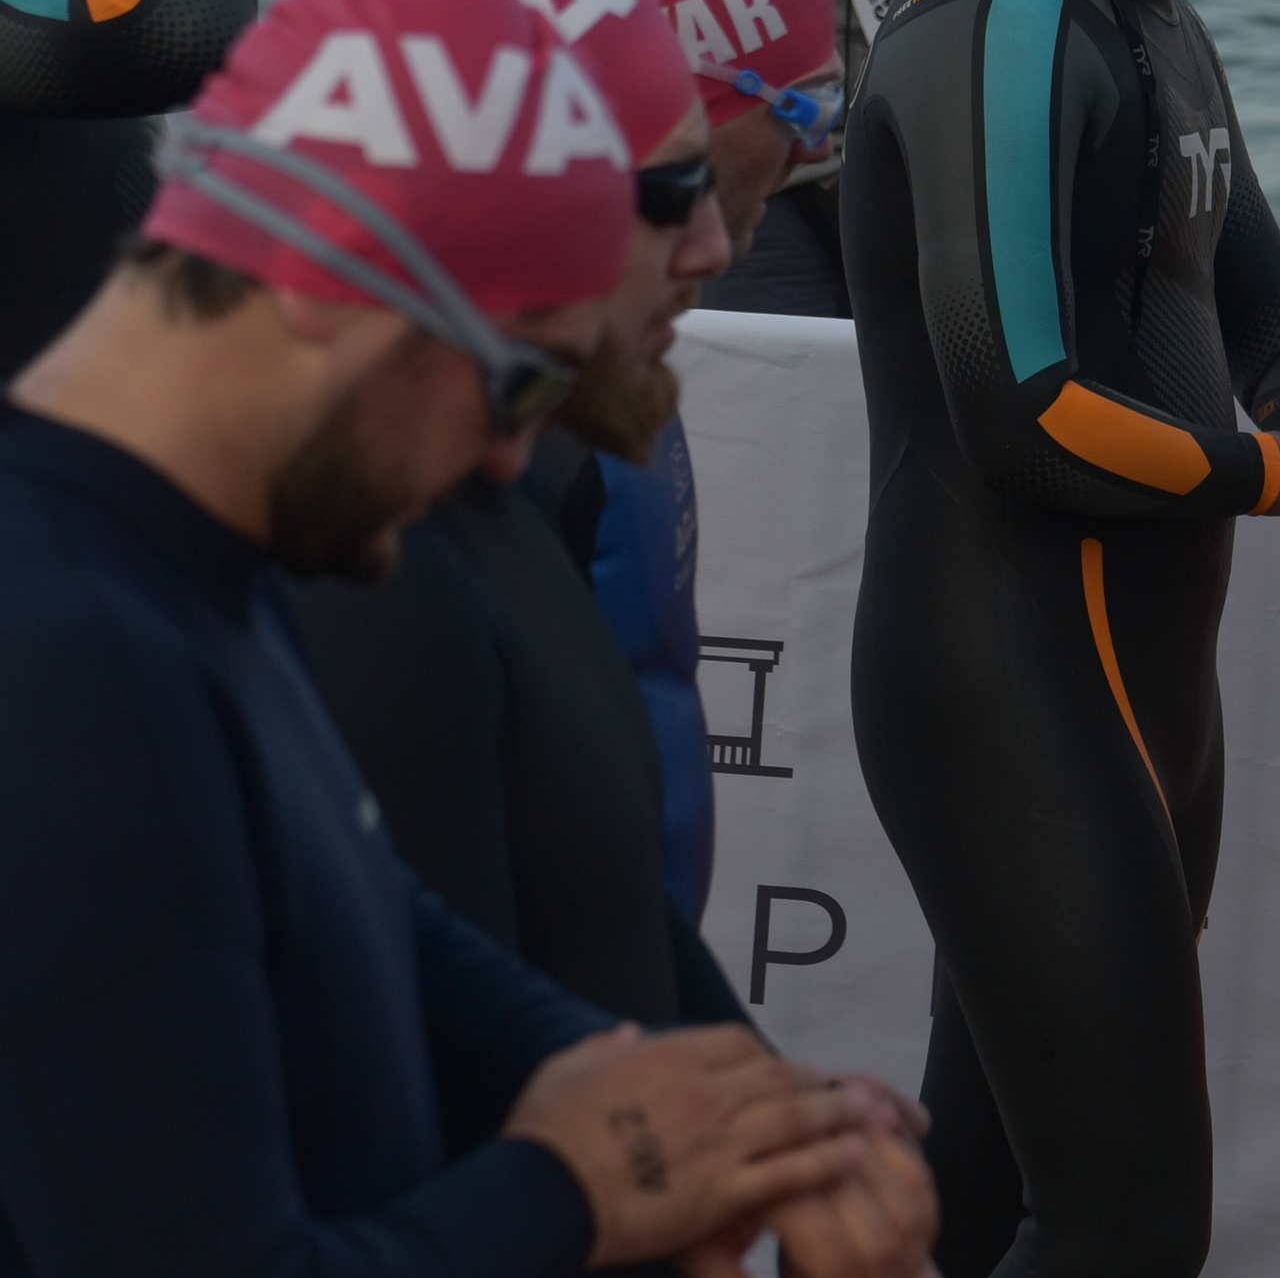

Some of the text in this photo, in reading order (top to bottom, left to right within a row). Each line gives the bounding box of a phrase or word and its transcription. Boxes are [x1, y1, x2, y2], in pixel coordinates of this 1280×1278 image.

[893, 0, 912, 21] FREE
[1133, 44, 1151, 77] TYR
[243, 30, 634, 179] AVA
[1147, 134, 1160, 167] TYR
[1138, 225, 1155, 259] TYR
